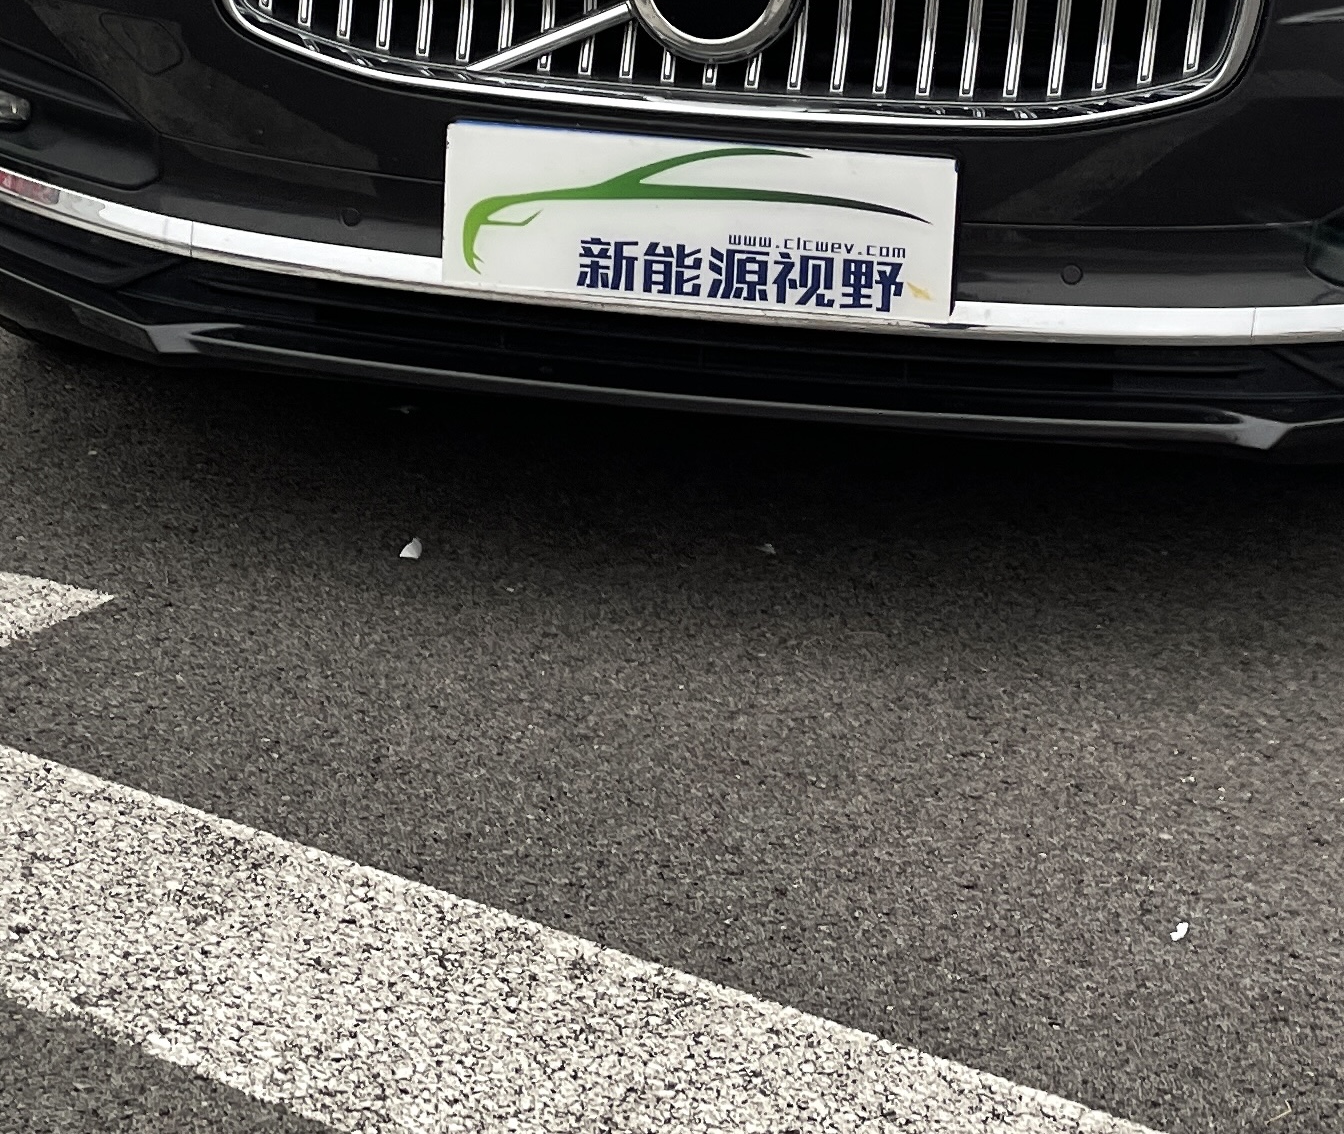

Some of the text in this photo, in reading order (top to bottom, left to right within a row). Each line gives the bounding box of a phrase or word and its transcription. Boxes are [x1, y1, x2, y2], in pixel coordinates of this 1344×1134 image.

[576, 237, 904, 312] 新能源视野
